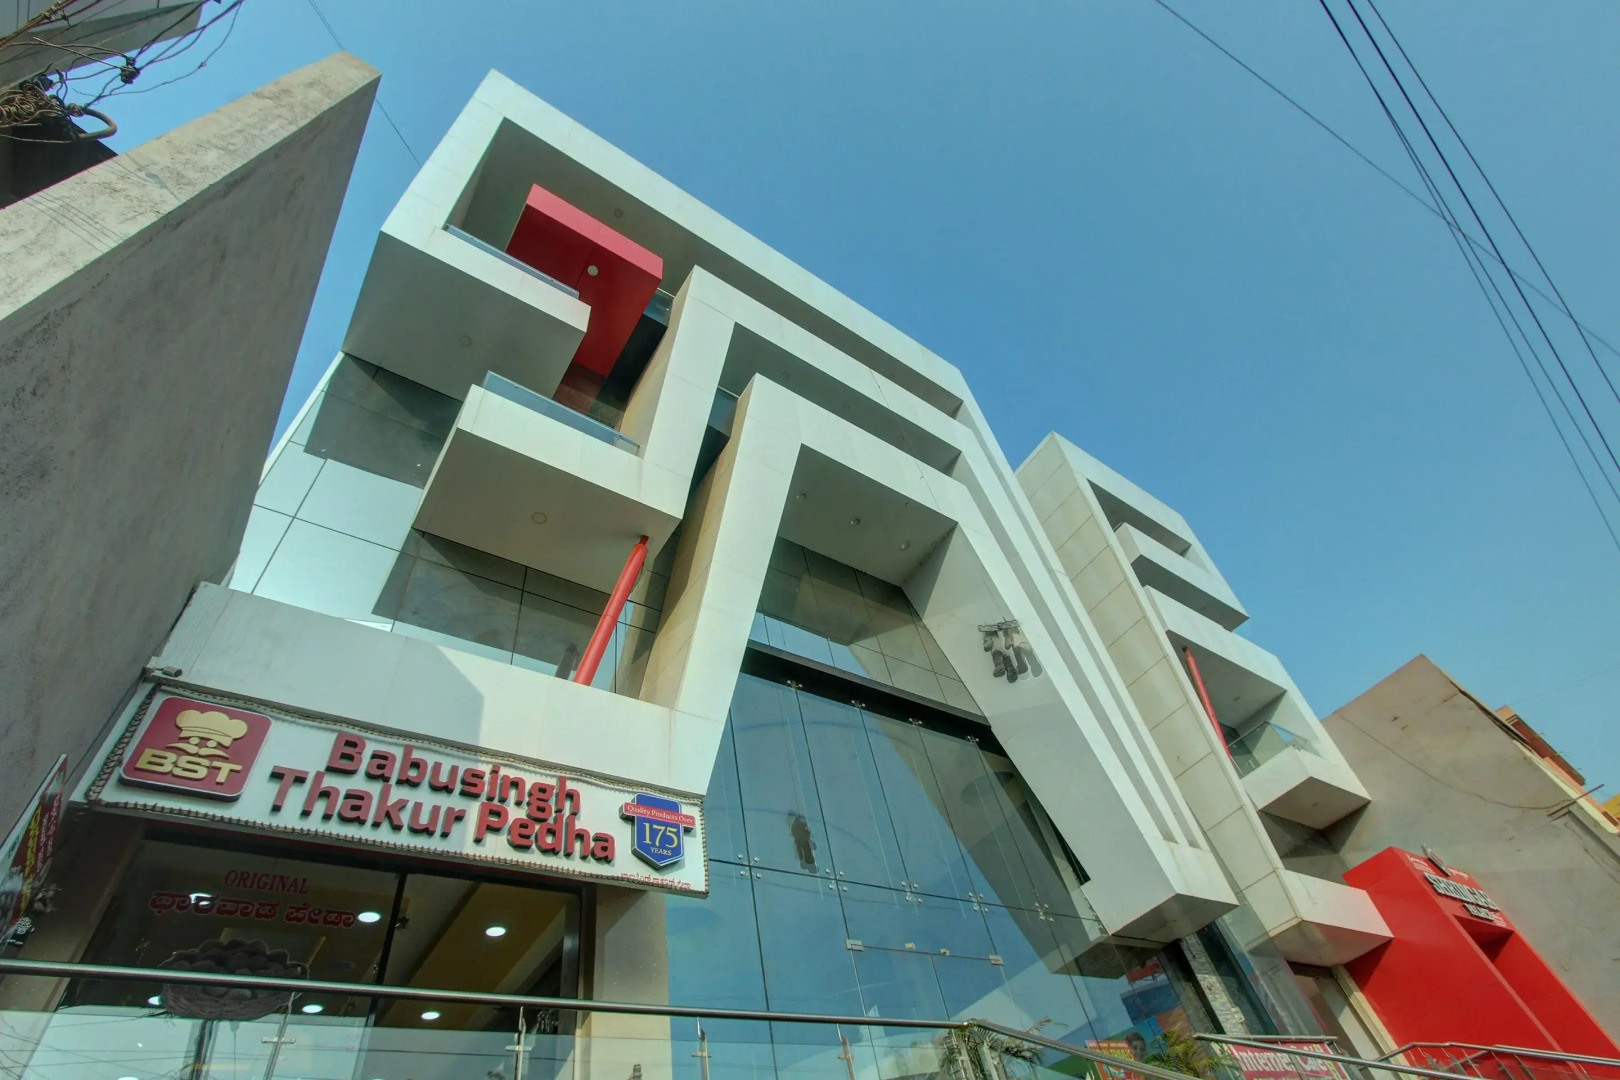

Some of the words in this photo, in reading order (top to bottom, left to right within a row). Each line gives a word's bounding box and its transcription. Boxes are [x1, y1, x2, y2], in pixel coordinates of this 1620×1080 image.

[134, 747, 243, 785] BST
[326, 732, 581, 822] Babusingh
[268, 765, 466, 838] Thakur
[473, 801, 616, 862] Pedha
[627, 804, 650, 816] Quality
[651, 809, 678, 820] Products
[678, 813, 694, 825] Over
[643, 822, 679, 848] 175
[650, 846, 672, 856] YEARS
[224, 869, 309, 895] ORIGINAL
